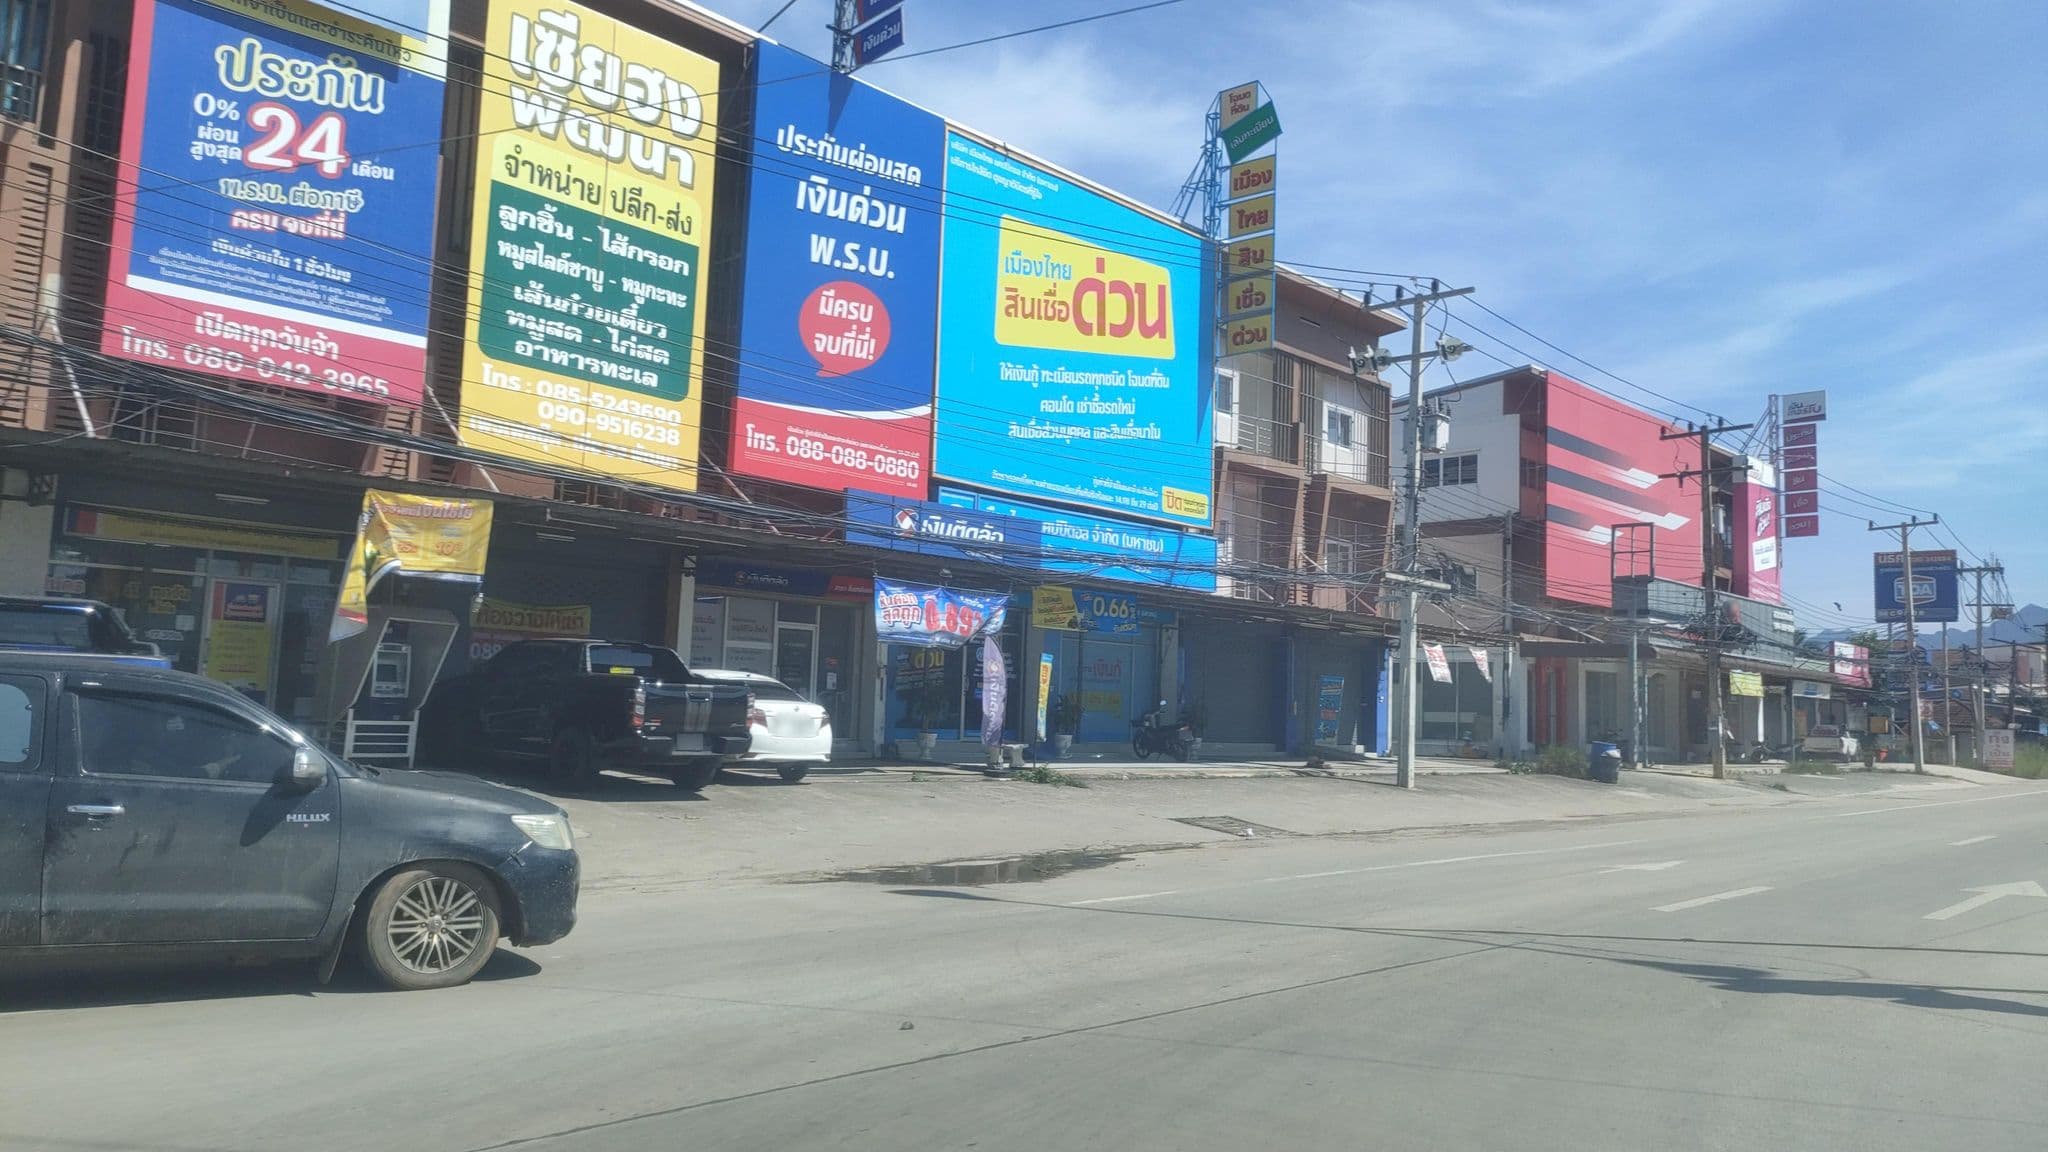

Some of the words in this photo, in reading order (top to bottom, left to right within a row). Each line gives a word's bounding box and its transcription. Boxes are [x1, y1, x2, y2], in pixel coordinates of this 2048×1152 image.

[863, 22, 901, 52] เงินด่วน
[214, 37, 385, 114] ประกัน
[193, 92, 241, 121] 0%
[196, 121, 240, 144] ผ่อน
[245, 102, 351, 178] 24
[351, 160, 395, 181] เดือน
[509, 80, 696, 190] พัฒนา
[190, 141, 242, 164] สูงสุด
[776, 124, 922, 188] ประกันผ่อนสด
[289, 180, 365, 213] ต่อภาษี
[503, 144, 602, 206] จำหน่าย
[610, 187, 693, 236] ปลีก-ส่ง
[1233, 166, 1273, 192] เมือง
[796, 175, 907, 234] เงินด่วน
[1236, 208, 1269, 231] ไทย
[498, 203, 574, 241] ลูกชิ้น
[596, 225, 690, 277] ไส้กรอก
[809, 233, 895, 280] พ.ร.บ.
[1237, 247, 1265, 268] สิน
[497, 239, 605, 293] หมูสไลด์ชาบู
[621, 275, 688, 309] หมูกะทะ
[1004, 249, 1072, 281] เมืองไทย
[818, 288, 874, 323] มีครบ
[1004, 283, 1071, 322] สินเชื่อ
[1072, 257, 1167, 339] ด่วน
[1235, 282, 1266, 311] เชื่อ
[194, 311, 340, 361] เปิดทุกวันจ้า
[505, 309, 584, 343] หมูสด
[606, 327, 671, 366] ไก่สด
[813, 324, 876, 361] จบที่นี่!
[1232, 324, 1268, 347] ด่วน
[514, 339, 660, 388] อาหารทะเล
[999, 361, 1040, 390] ให้เงินกู้
[1041, 365, 1126, 391] ทะเบียนรถทุกชนิด
[1127, 367, 1170, 389] โฉนดที่ดิน
[1040, 395, 1074, 414] คอนโด
[1077, 393, 1136, 415] เช่าซื้อรถใหม่
[537, 400, 681, 447] 090-9516238
[785, 435, 920, 480] 088-088-0880
[921, 513, 1004, 543] เงินติดล้อ
[1093, 596, 1129, 618] 0.66
[286, 812, 331, 822] HILUX
